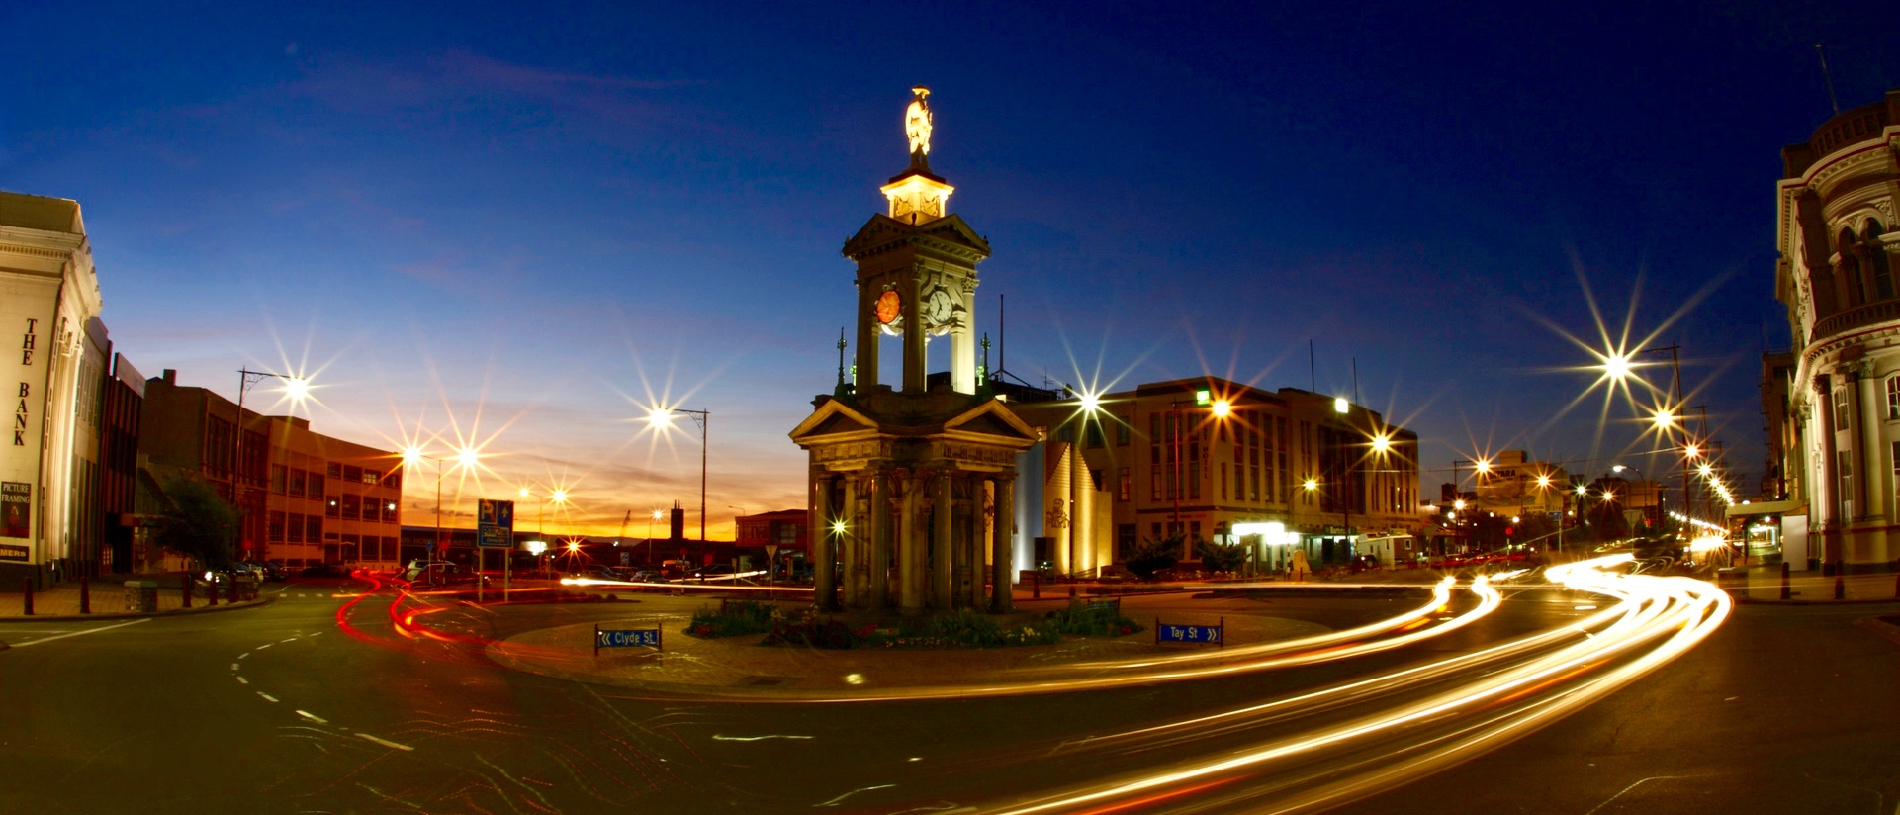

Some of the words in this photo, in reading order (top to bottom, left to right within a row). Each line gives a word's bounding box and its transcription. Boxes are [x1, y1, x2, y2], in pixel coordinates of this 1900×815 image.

[22, 318, 38, 366] THE
[14, 382, 30, 446] BANK
[3, 483, 30, 494] PICTURE
[1, 494, 31, 503] FRAMING
[0, 549, 26, 557] MERS
[615, 632, 640, 645] Clyde
[643, 631, 654, 643] St
[1170, 626, 1185, 640] Tay
[1188, 627, 1198, 638] St
